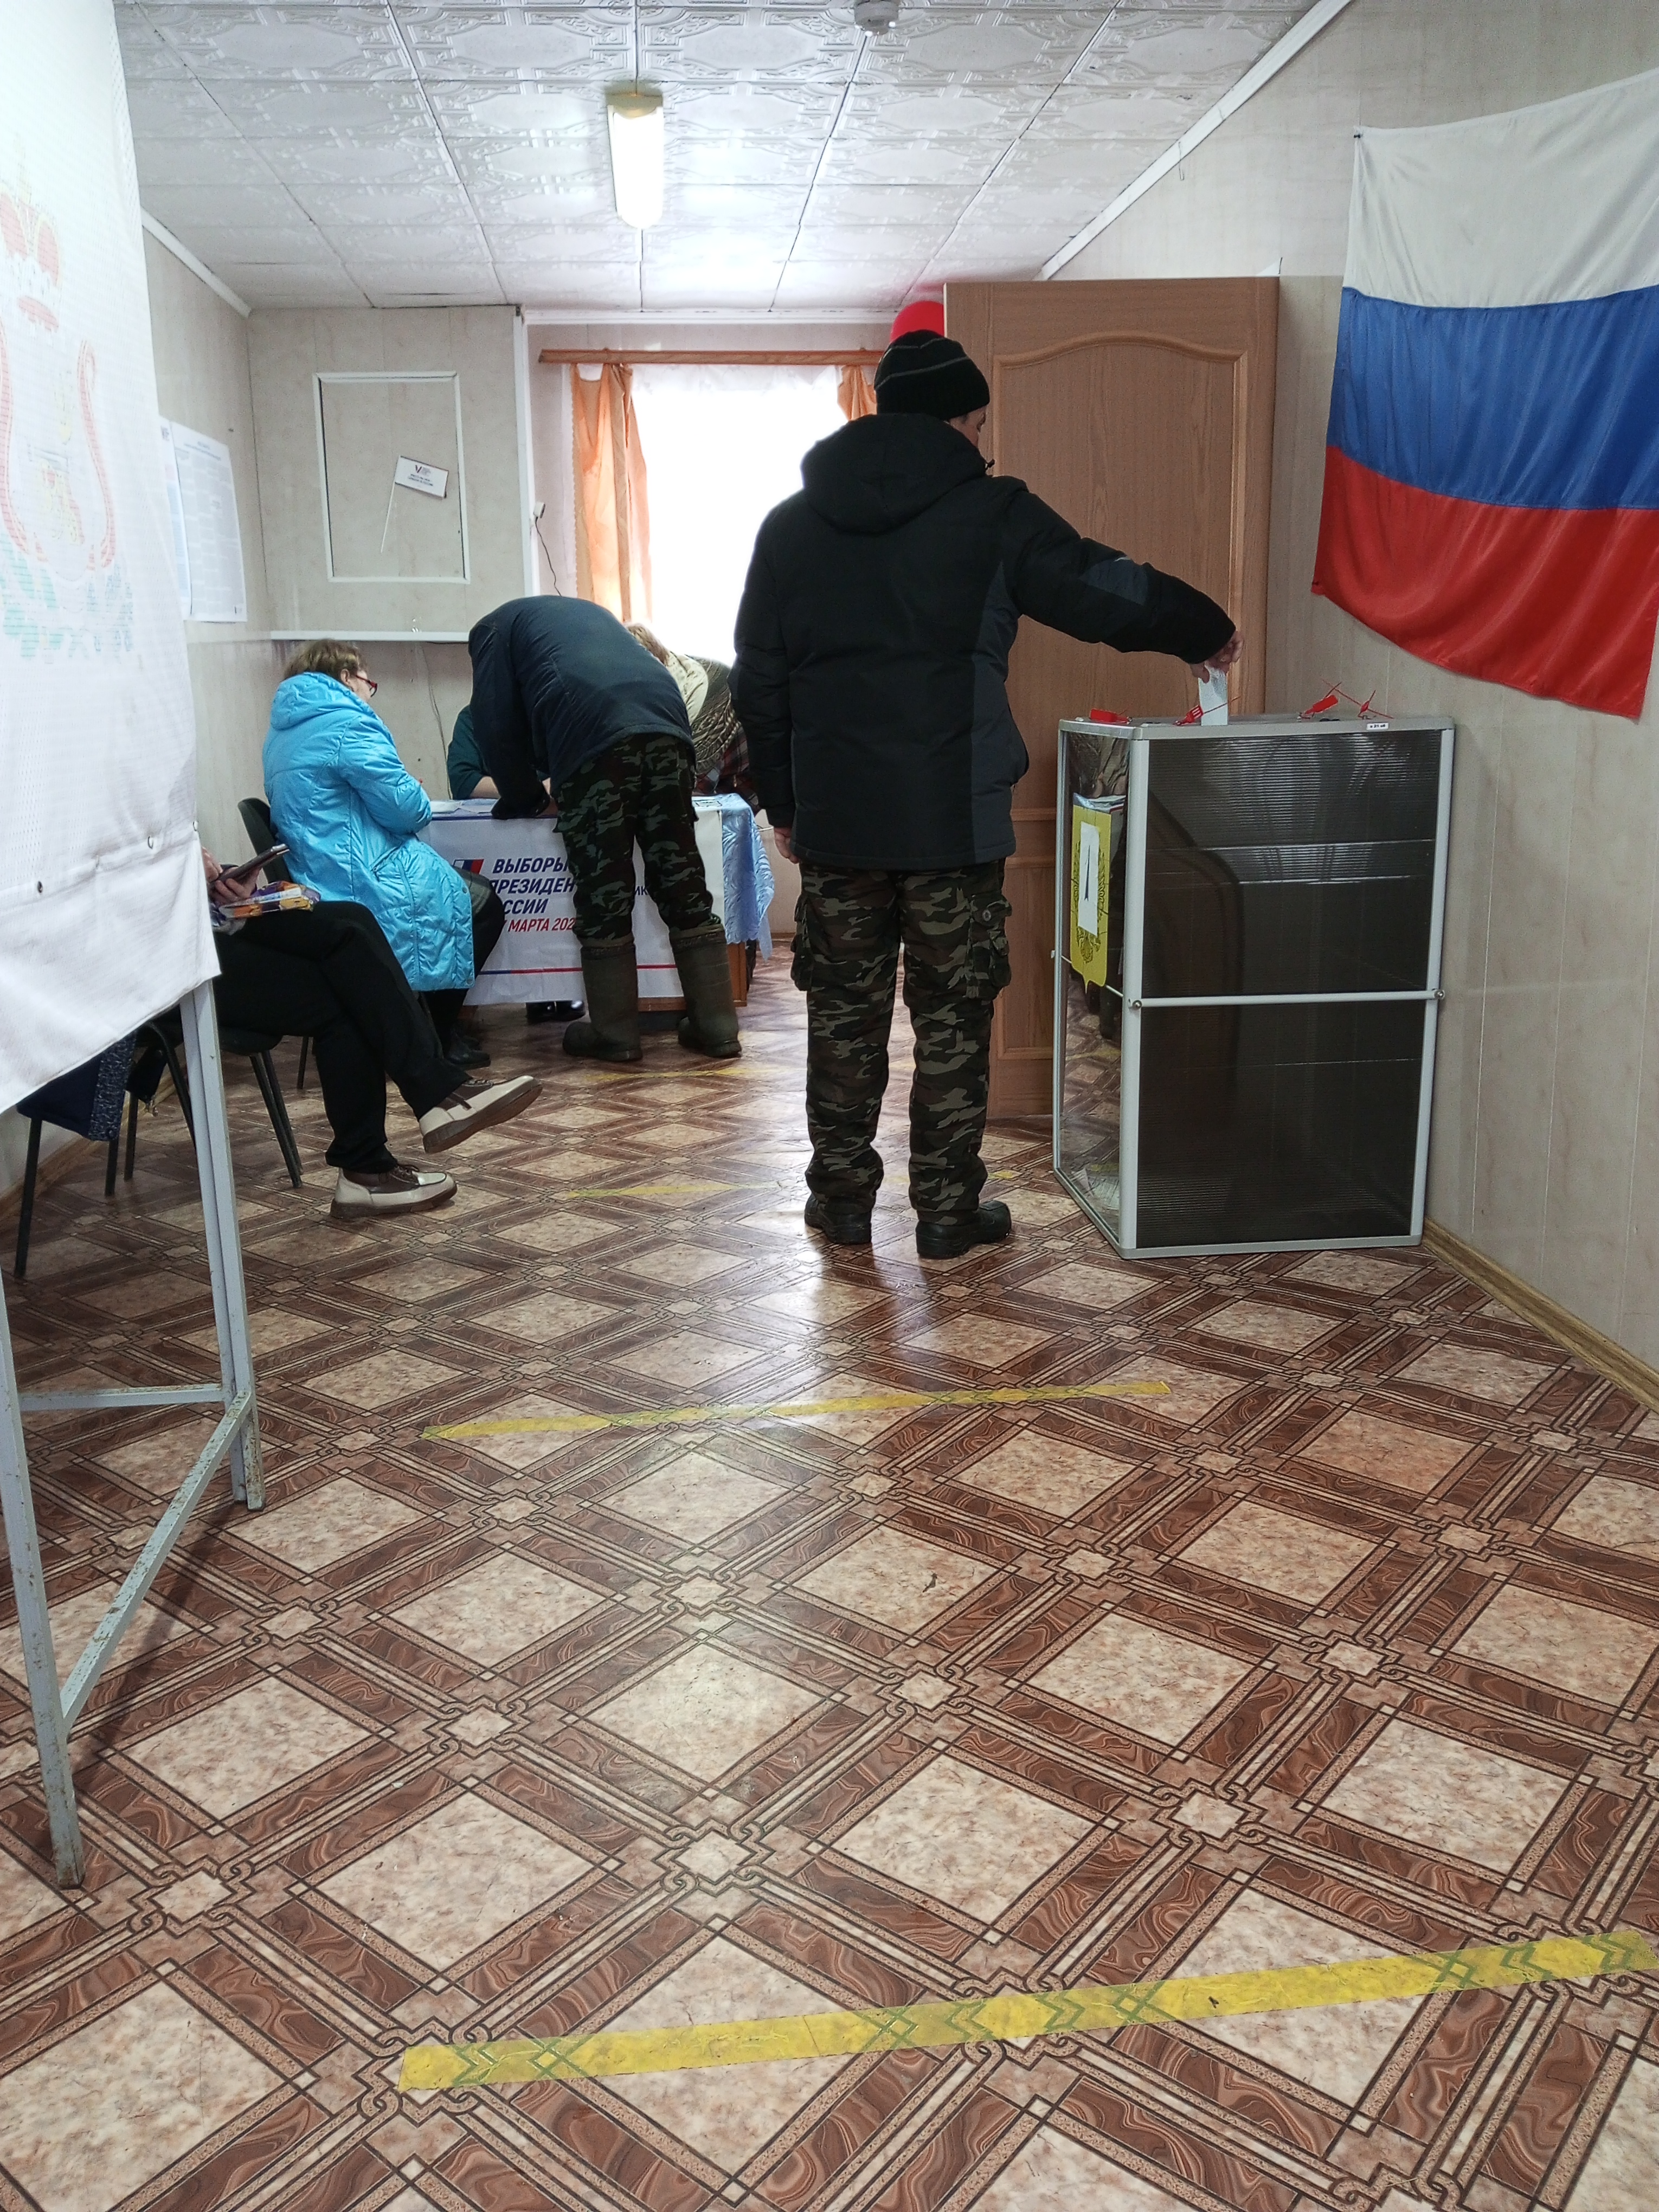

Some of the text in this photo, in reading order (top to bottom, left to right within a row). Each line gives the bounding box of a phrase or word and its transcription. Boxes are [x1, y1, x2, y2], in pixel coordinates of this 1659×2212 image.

[492, 857, 569, 874] ВЫБОРЫ
[489, 878, 575, 895] ПРЕЗИДЕН
[503, 898, 549, 915] ССИИ
[508, 917, 576, 933] МАРТА 202
